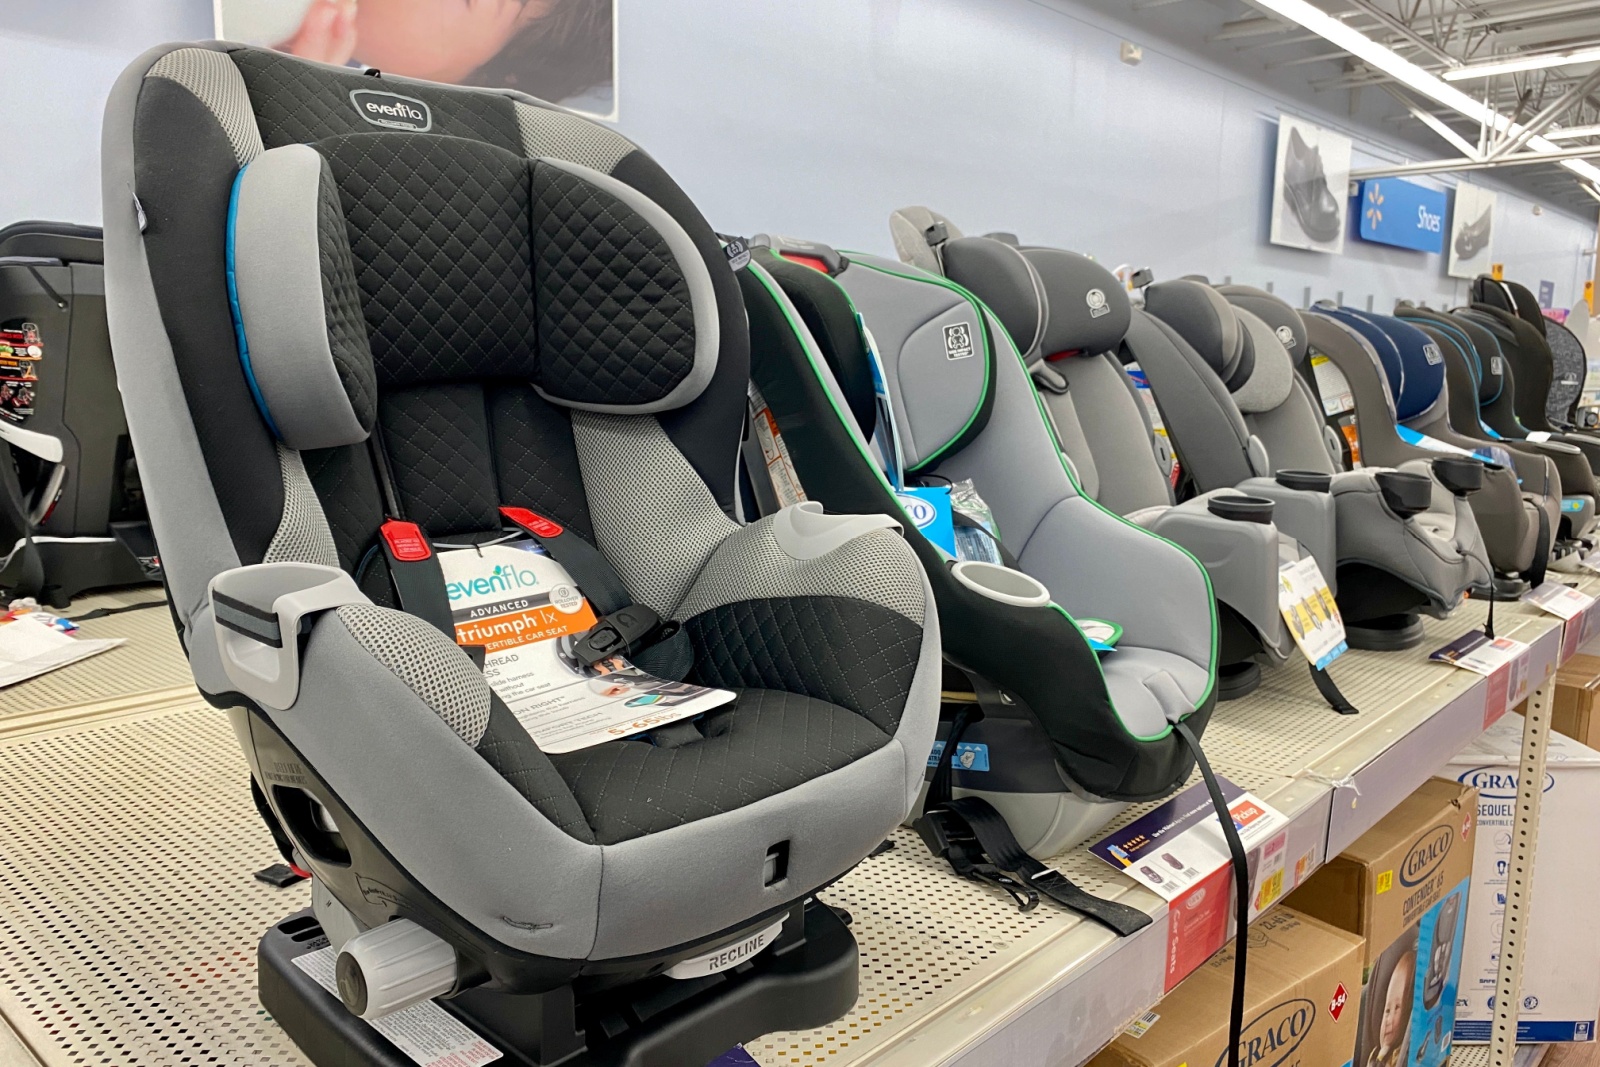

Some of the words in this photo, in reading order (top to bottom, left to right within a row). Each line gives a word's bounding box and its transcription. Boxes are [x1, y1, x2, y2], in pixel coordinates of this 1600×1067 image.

[366, 102, 423, 121] evenflo
[1416, 205, 1442, 233] Shoes
[445, 565, 540, 600] evenflo
[470, 599, 529, 618] ADVANCED
[526, 631, 546, 641] CAR
[546, 625, 567, 637] SEAT
[485, 654, 519, 668] HREAD
[1472, 772, 1519, 789] GRA
[1233, 807, 1258, 823] Pickup
[1408, 832, 1449, 876] GRACO
[1403, 877, 1436, 916] CONTENDER
[709, 934, 764, 970] RECLINE
